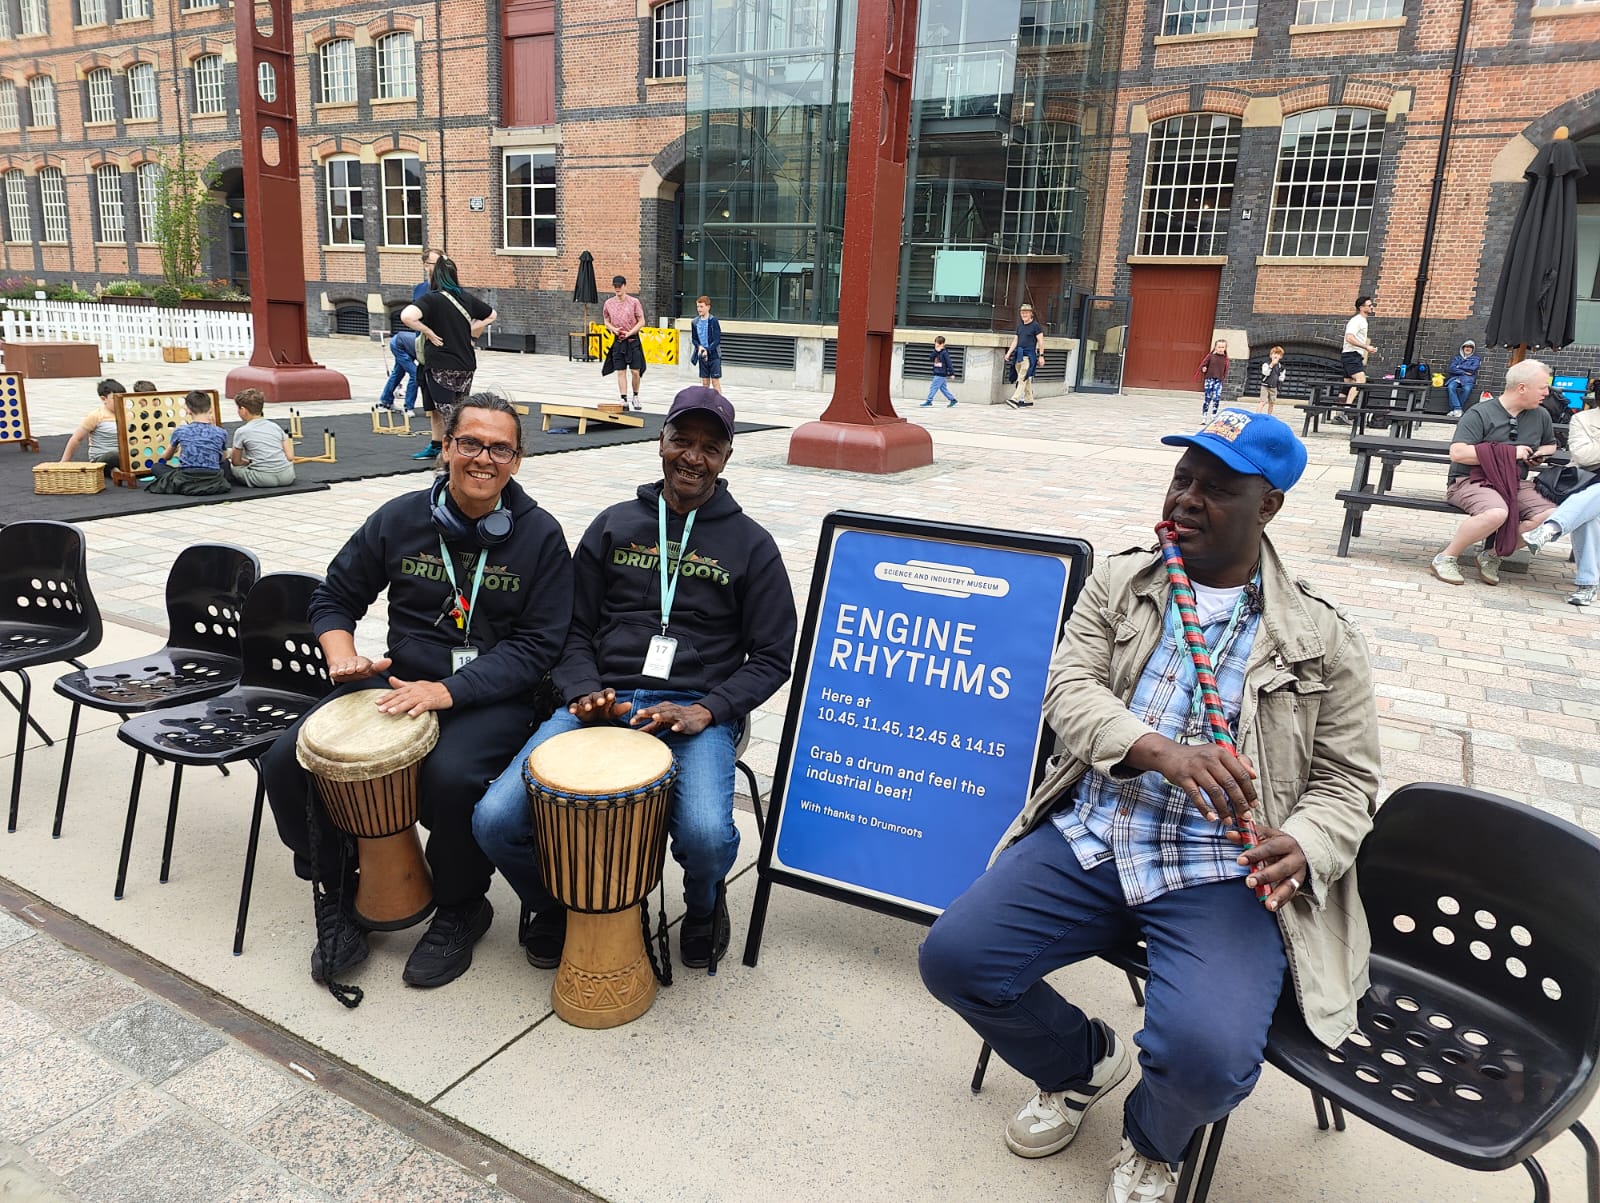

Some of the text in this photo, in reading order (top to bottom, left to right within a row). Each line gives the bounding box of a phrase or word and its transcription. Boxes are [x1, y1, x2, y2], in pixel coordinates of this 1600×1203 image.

[883, 568, 999, 591] SCIENCE AND INDUSTRY MUSEUM
[836, 603, 977, 656] ENGINE
[458, 656, 472, 665] 18
[655, 644, 668, 655] 17
[829, 638, 1012, 700] RHYTHMS
[821, 687, 872, 709] Here at
[817, 706, 1006, 758] 10.45, 11.45, 12.45 & 14.15
[806, 766, 914, 801] industrial beat!
[810, 745, 986, 797] Grab a drum and feel the
[800, 800, 923, 839] With thanks to Drumroots
